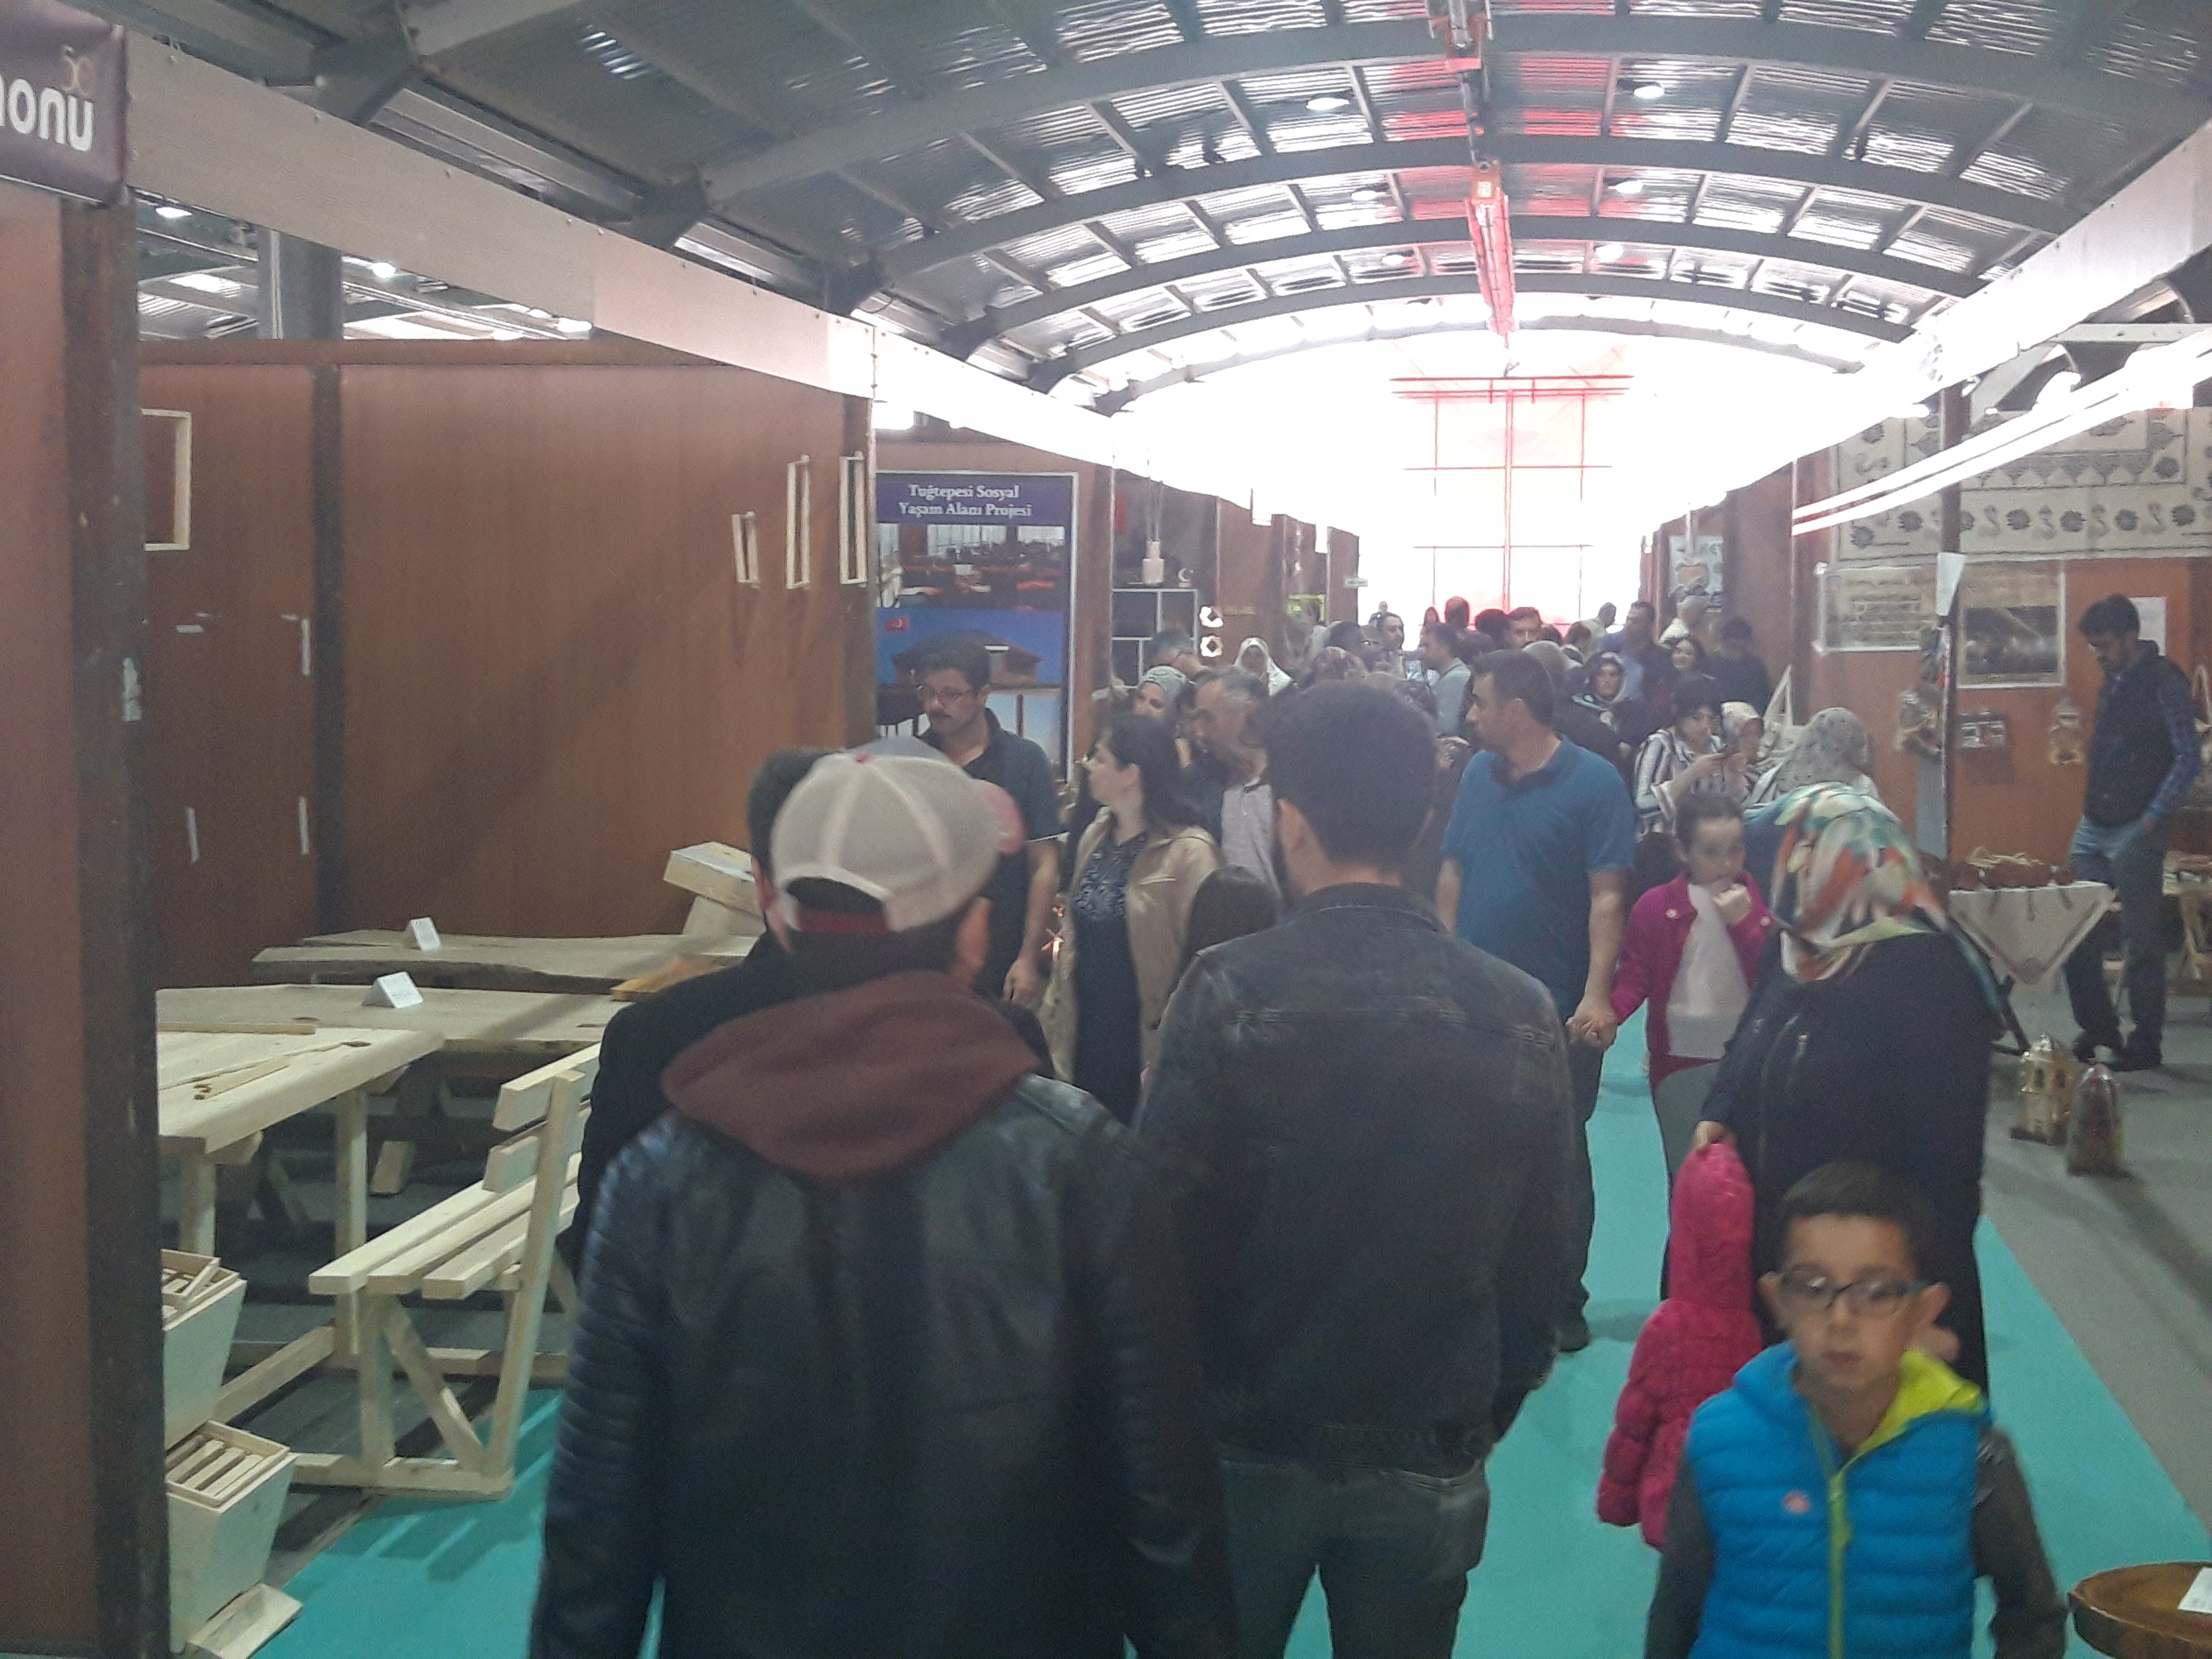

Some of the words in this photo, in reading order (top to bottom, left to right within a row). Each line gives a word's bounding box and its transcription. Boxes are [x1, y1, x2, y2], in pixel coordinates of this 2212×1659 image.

[909, 484, 974, 501] Tuğtepesi
[976, 485, 1020, 501] Sosyal
[898, 502, 943, 518] Yaşam
[946, 502, 982, 516] Alanı
[986, 503, 1032, 519] Projesi
